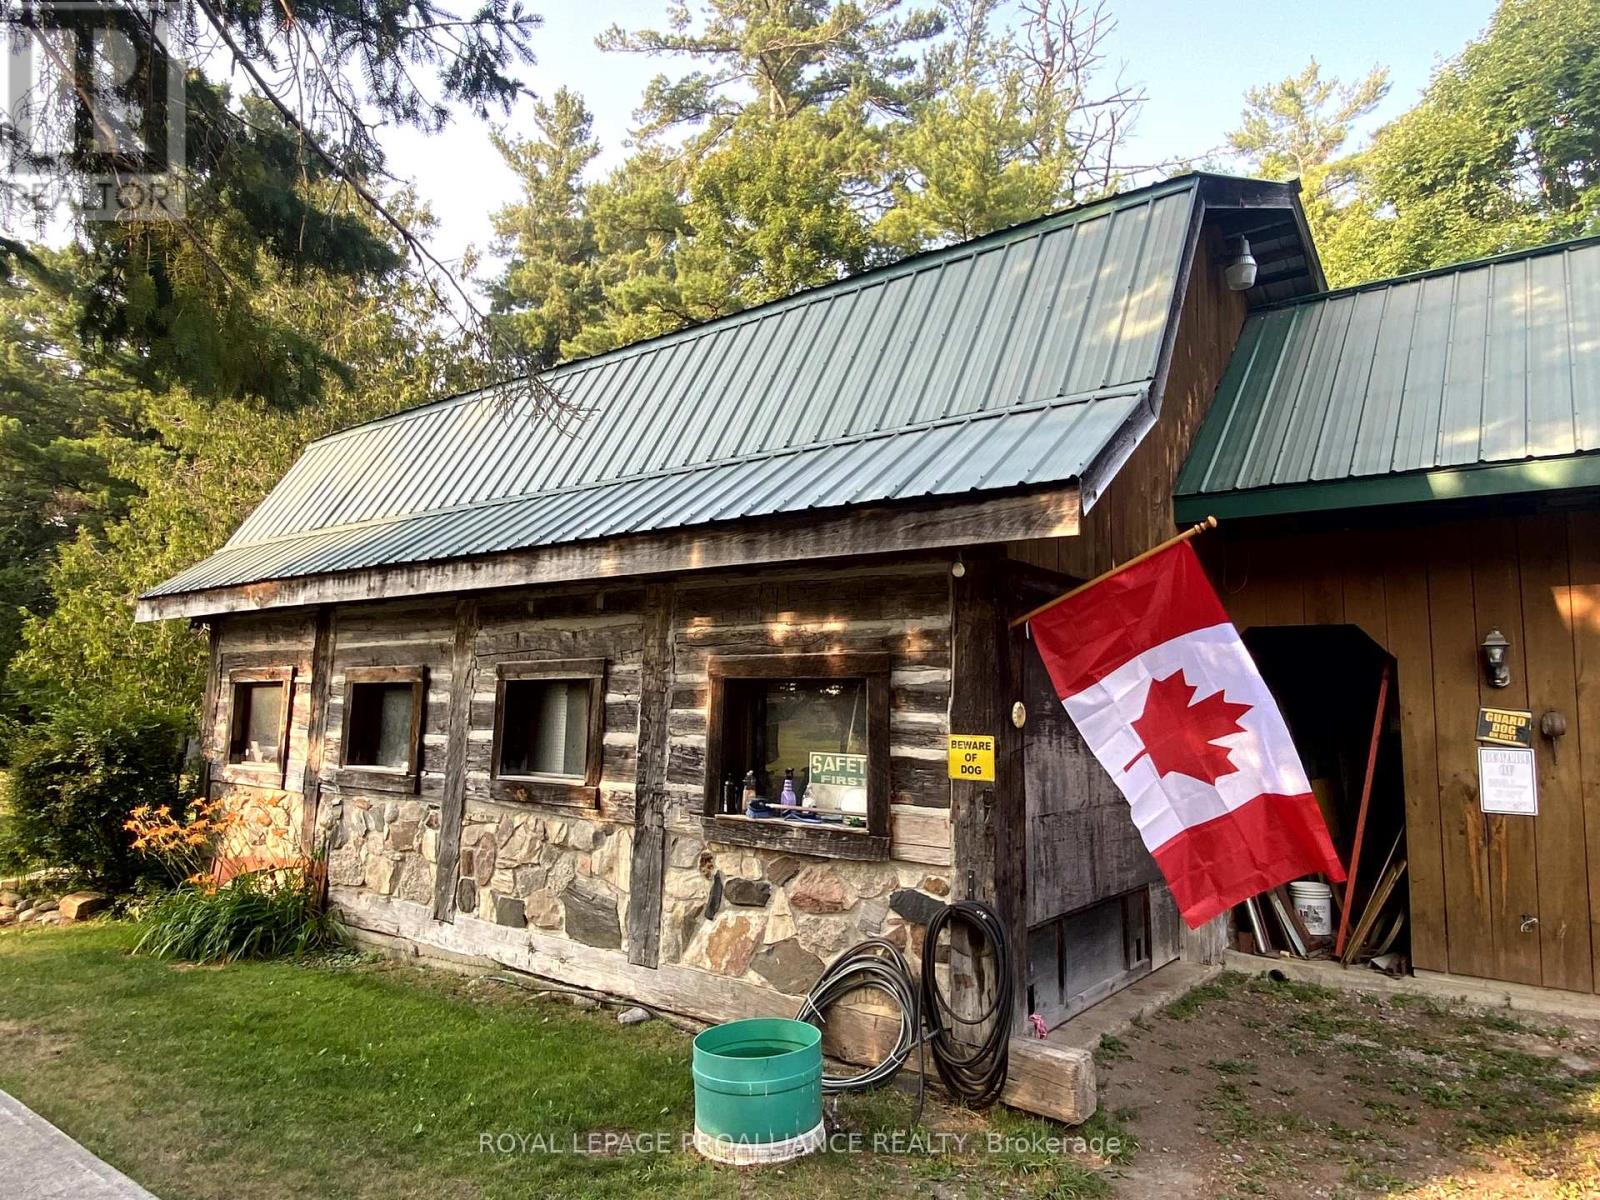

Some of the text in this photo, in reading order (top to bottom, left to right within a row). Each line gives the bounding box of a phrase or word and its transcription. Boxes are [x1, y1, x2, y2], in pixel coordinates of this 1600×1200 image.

[1485, 712, 1526, 727] GUARD
[1492, 722, 1516, 735] DOG
[951, 740, 991, 751] BEWARE
[964, 753, 977, 762] OF
[812, 755, 867, 775] SAFET
[961, 765, 982, 775] DOG
[820, 774, 867, 786] FIRST
